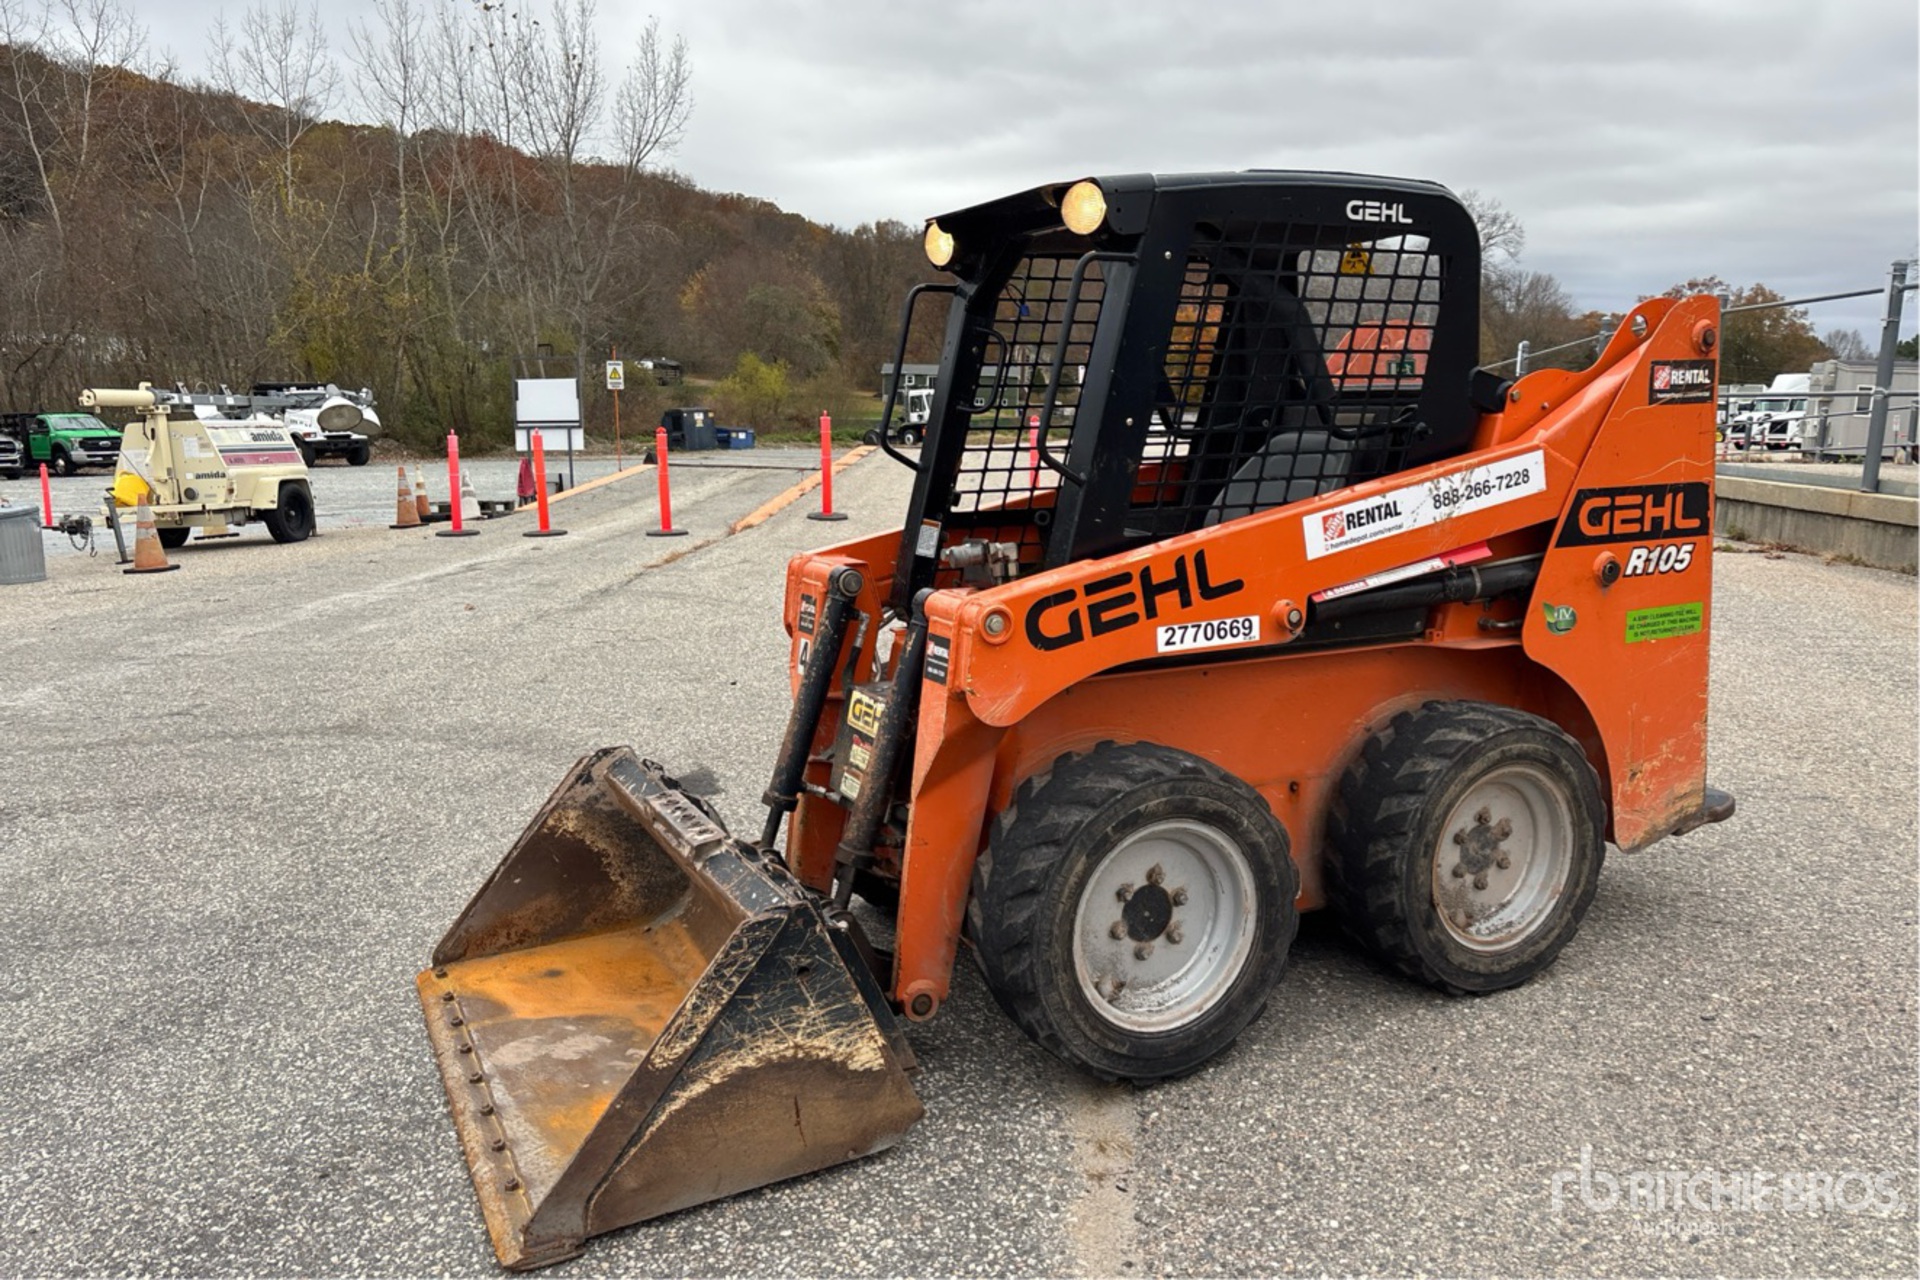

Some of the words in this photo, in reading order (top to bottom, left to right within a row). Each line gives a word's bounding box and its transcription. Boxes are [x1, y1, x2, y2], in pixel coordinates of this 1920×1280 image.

[1346, 199, 1413, 224] GEHL
[1670, 368, 1711, 385] RENTAL
[250, 430, 285, 442] amida
[195, 471, 226, 480] amida
[1432, 468, 1531, 510] 888-266-7228
[1346, 500, 1402, 531] RENTAL
[1578, 490, 1702, 537] GEHL
[1330, 523, 1404, 549] homedepot.com/rental
[1624, 545, 1695, 577] R105
[1025, 548, 1245, 651] GEHL
[1163, 617, 1253, 647] 2770669
